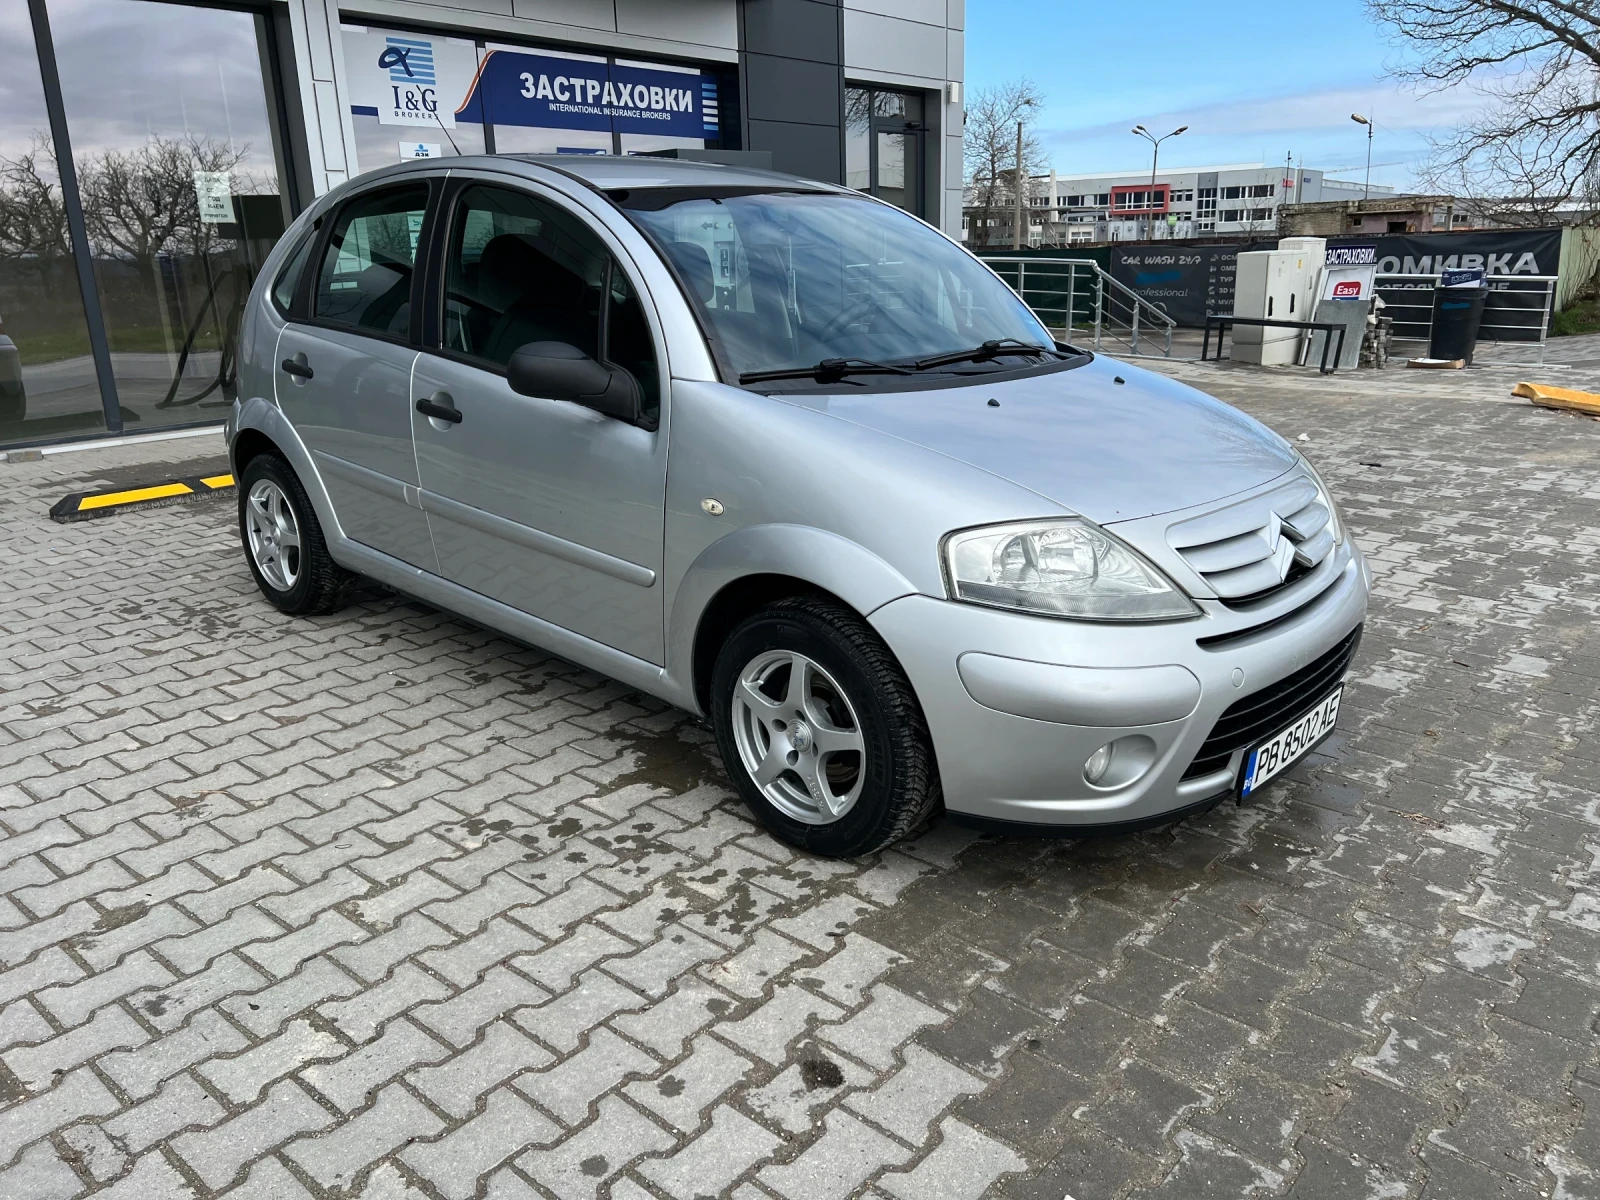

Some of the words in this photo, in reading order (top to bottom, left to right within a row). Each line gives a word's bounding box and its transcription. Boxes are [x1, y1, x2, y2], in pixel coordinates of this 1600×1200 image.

[519, 72, 693, 113] ЗАСТРАХОВКИ
[394, 110, 438, 120] BROKERS
[549, 103, 602, 115] INTERNATIONAL
[603, 107, 640, 118] INSURANCE
[641, 111, 671, 120] BROKERS
[1121, 255, 1141, 265] CAR
[1144, 255, 1175, 265] WASH
[1178, 255, 1202, 265] 24/7
[1326, 248, 1375, 264] ЗАСТРАХОВКИ
[1374, 252, 1540, 275] ОМИВКА
[1336, 285, 1359, 296] Easy
[1254, 740, 1281, 783] PB
[1281, 710, 1320, 763] 8502
[1318, 692, 1340, 734] AE
[1243, 776, 1253, 790] BG
